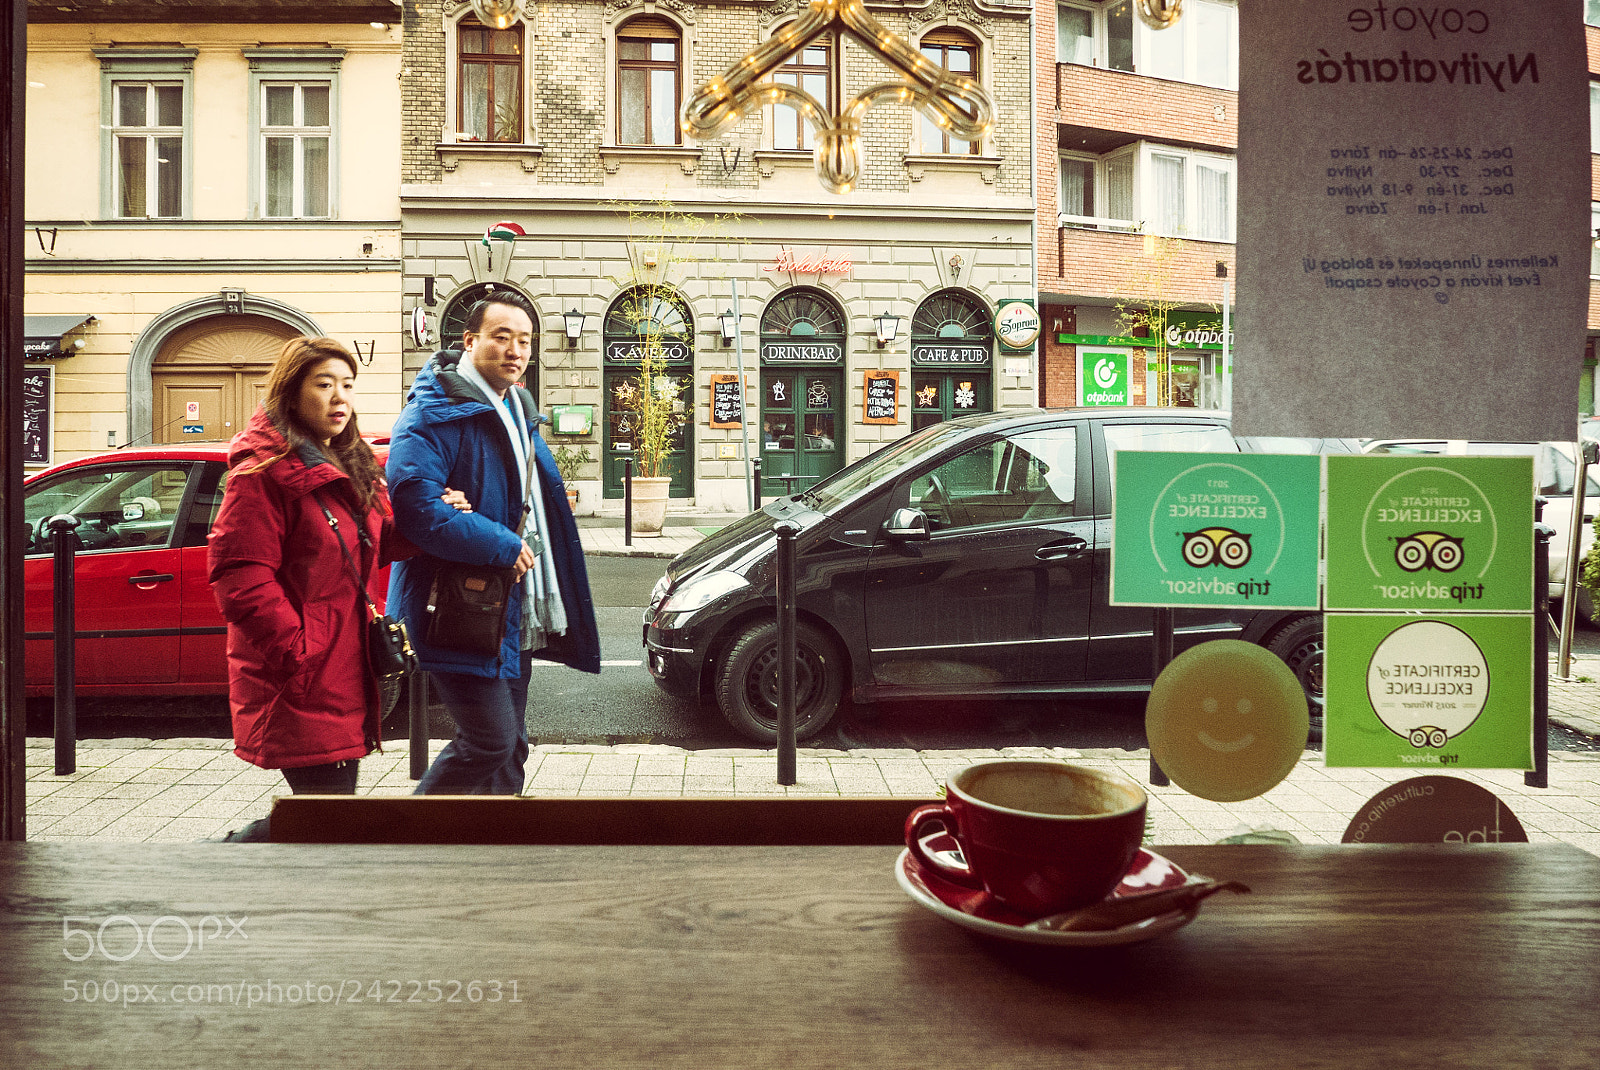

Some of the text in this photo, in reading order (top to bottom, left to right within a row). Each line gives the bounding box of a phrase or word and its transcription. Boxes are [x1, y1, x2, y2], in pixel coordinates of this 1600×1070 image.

[999, 316, 1038, 336] Soproni
[1184, 327, 1235, 349] otpban
[768, 346, 836, 360] DRINKBAR
[918, 348, 983, 362] CAFE & PUB
[1086, 391, 1125, 405] otpbank
